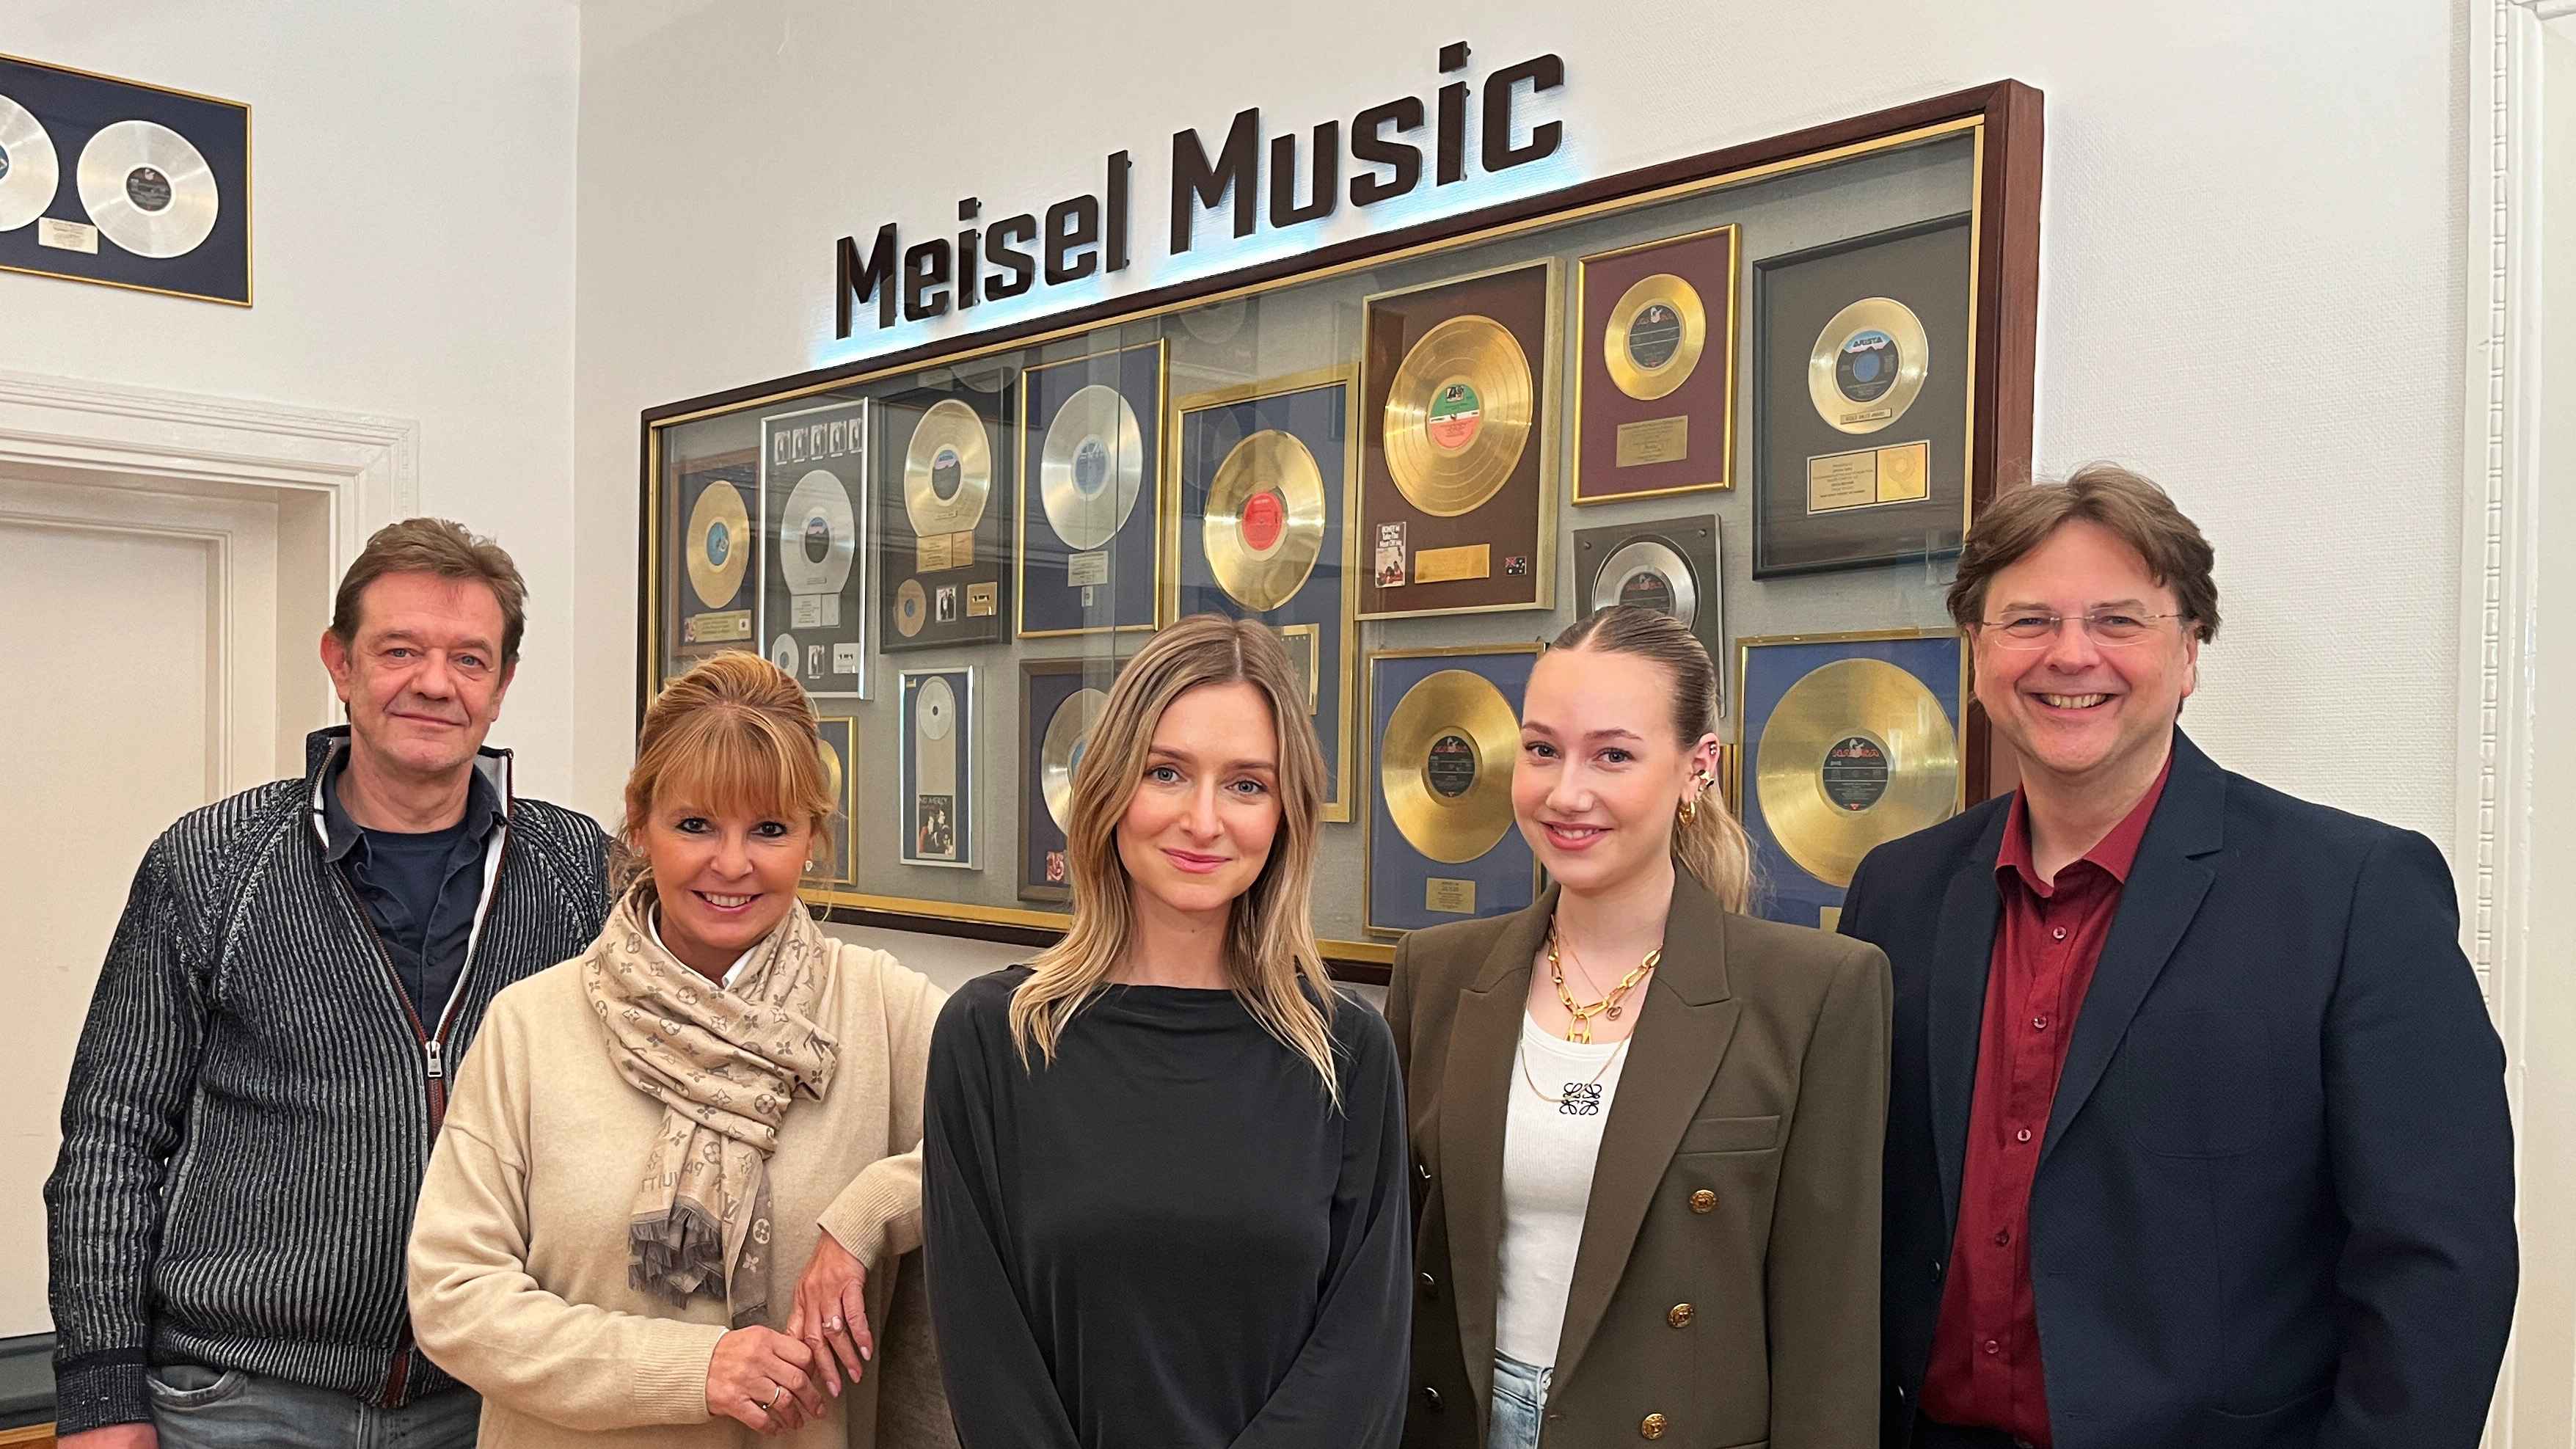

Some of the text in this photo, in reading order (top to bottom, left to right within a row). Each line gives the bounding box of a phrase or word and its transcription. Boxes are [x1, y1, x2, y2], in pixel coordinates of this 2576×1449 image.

[835, 40, 1564, 340] Meisel Music
[1853, 336, 1883, 348] ARISTA
